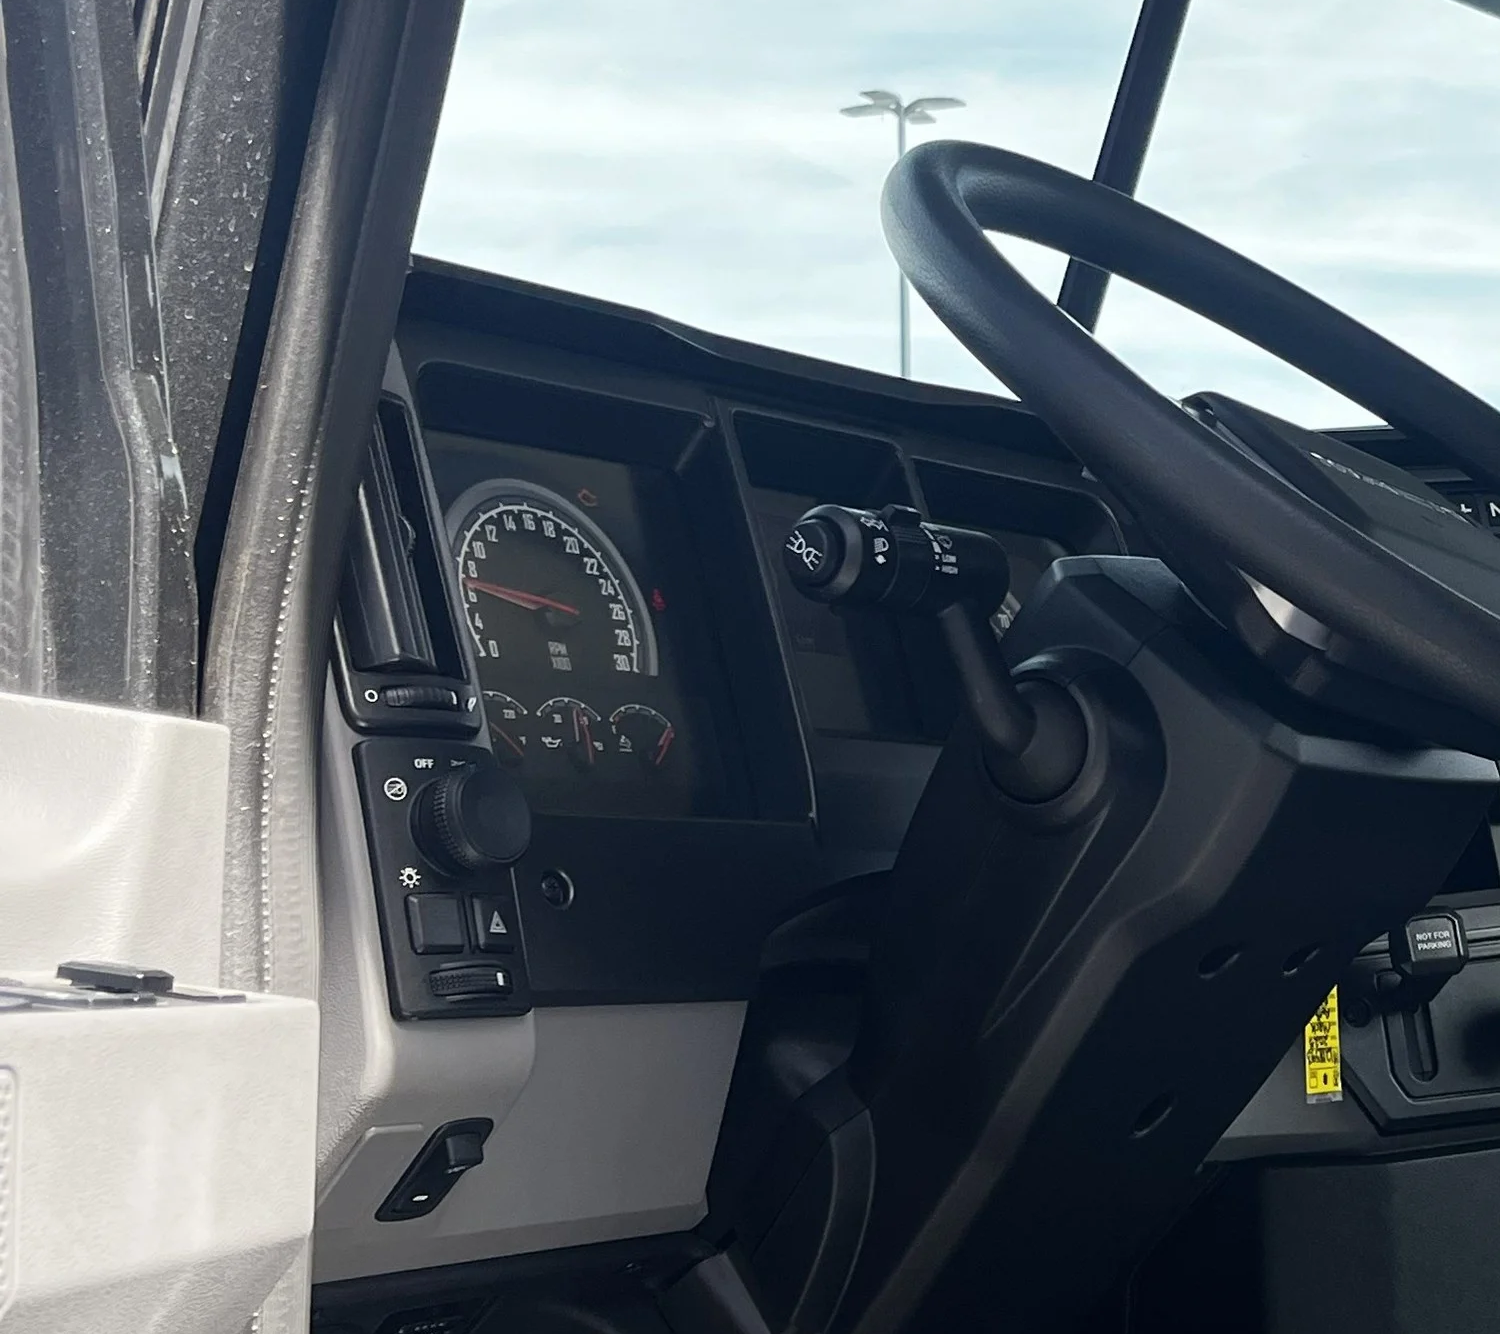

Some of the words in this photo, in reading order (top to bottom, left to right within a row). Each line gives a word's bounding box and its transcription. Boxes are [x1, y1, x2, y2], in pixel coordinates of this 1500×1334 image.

[503, 515, 516, 531] 14
[522, 513, 536, 531] 16
[542, 521, 556, 538] 18
[485, 525, 498, 543] 12
[472, 541, 486, 559] 10
[563, 536, 580, 554] 20
[467, 561, 478, 578] 8
[583, 557, 600, 575] 22
[468, 588, 478, 603] 6
[598, 579, 615, 595] 24
[609, 603, 626, 621] 26
[474, 613, 484, 629] 4
[614, 629, 632, 647] 28
[488, 640, 499, 657] 0
[548, 641, 568, 656] RPM
[613, 654, 630, 671] 30
[414, 759, 434, 769] OFF
[1416, 933, 1432, 941] NOT
[1434, 931, 1450, 939] FOR
[1418, 940, 1452, 951] PARKING
